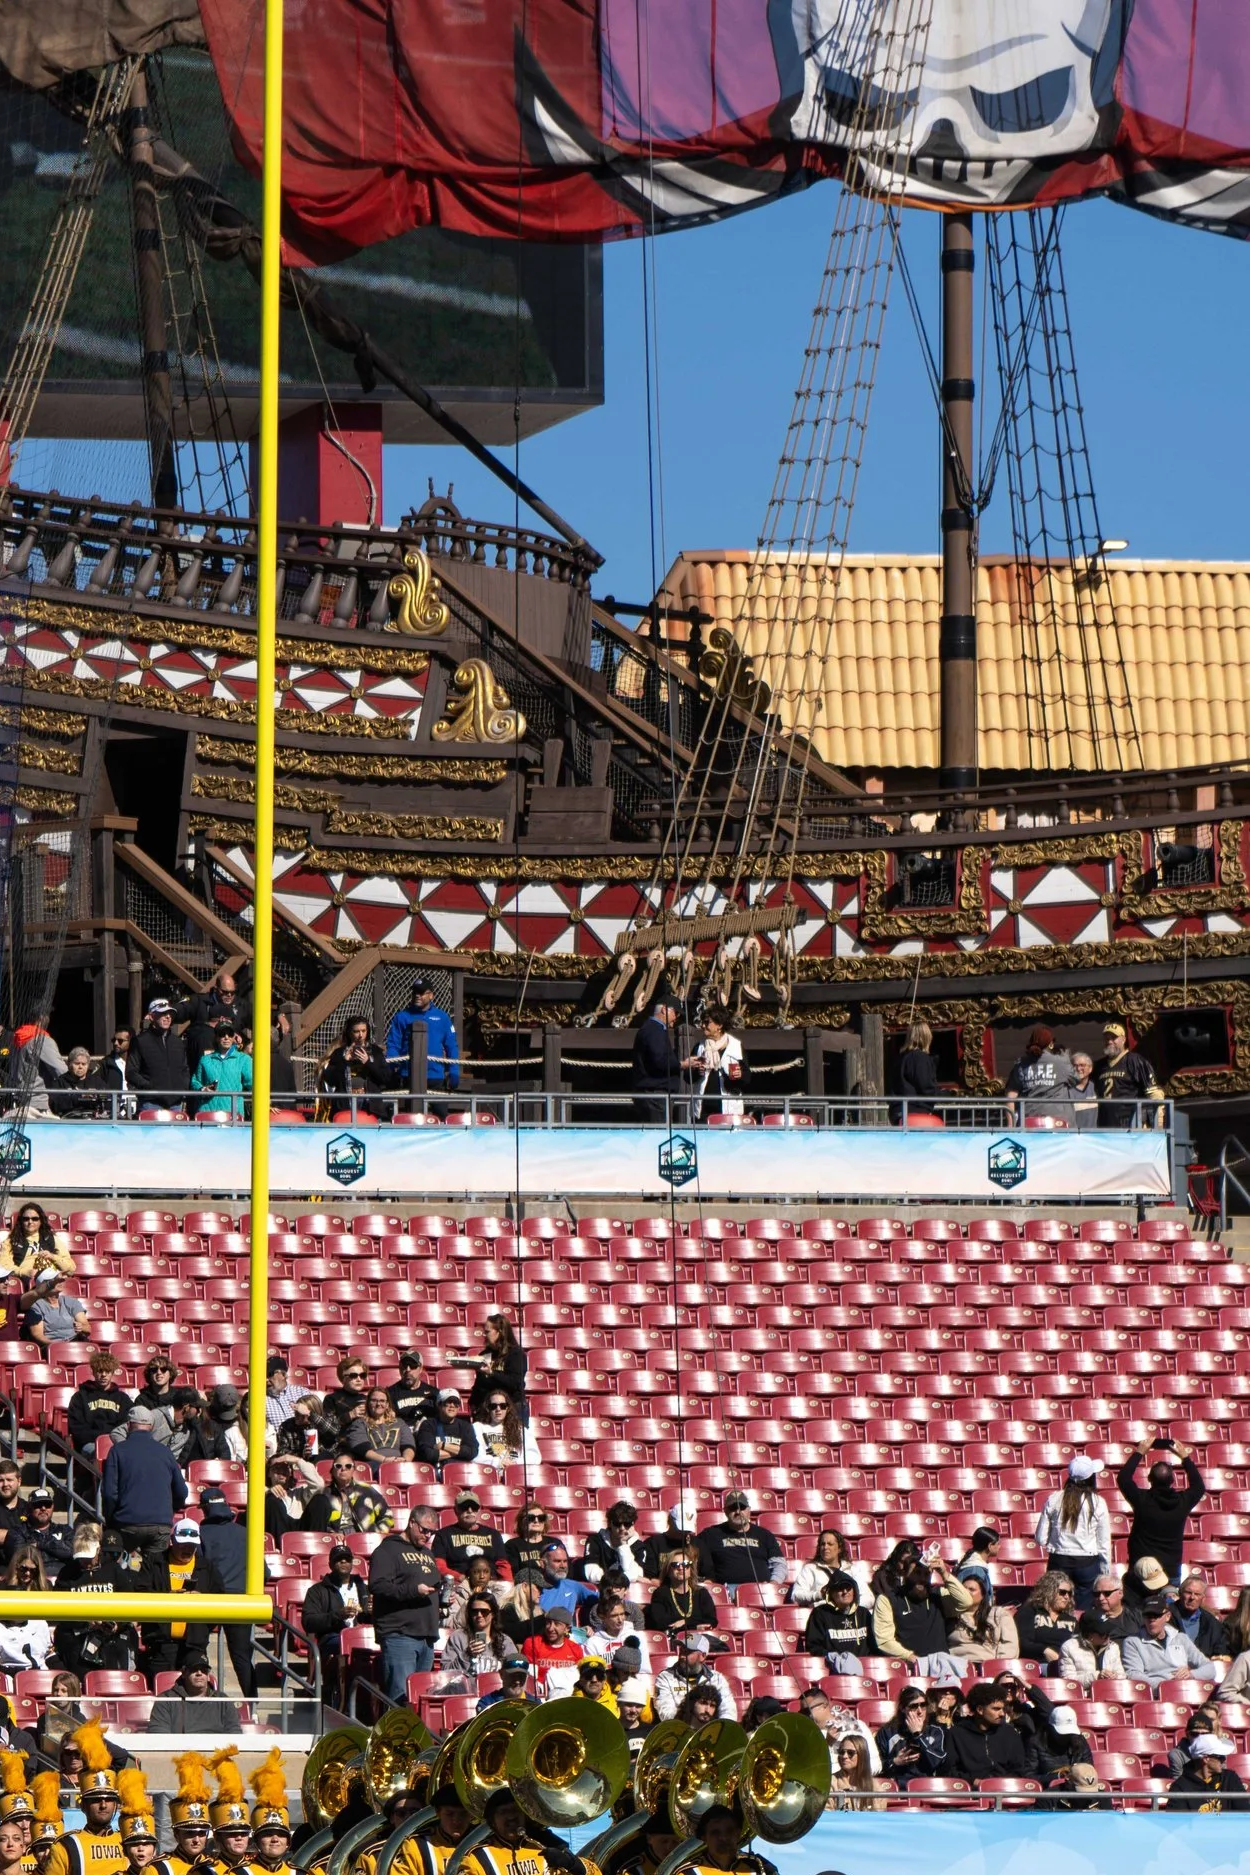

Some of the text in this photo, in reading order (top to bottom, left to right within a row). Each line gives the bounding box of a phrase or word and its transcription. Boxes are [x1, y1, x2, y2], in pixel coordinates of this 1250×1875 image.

[451, 1534, 493, 1548] VANDERBILT
[402, 1552, 436, 1566] IOWA
[1086, 1777, 1095, 1786] V
[90, 1844, 122, 1860] IOWA
